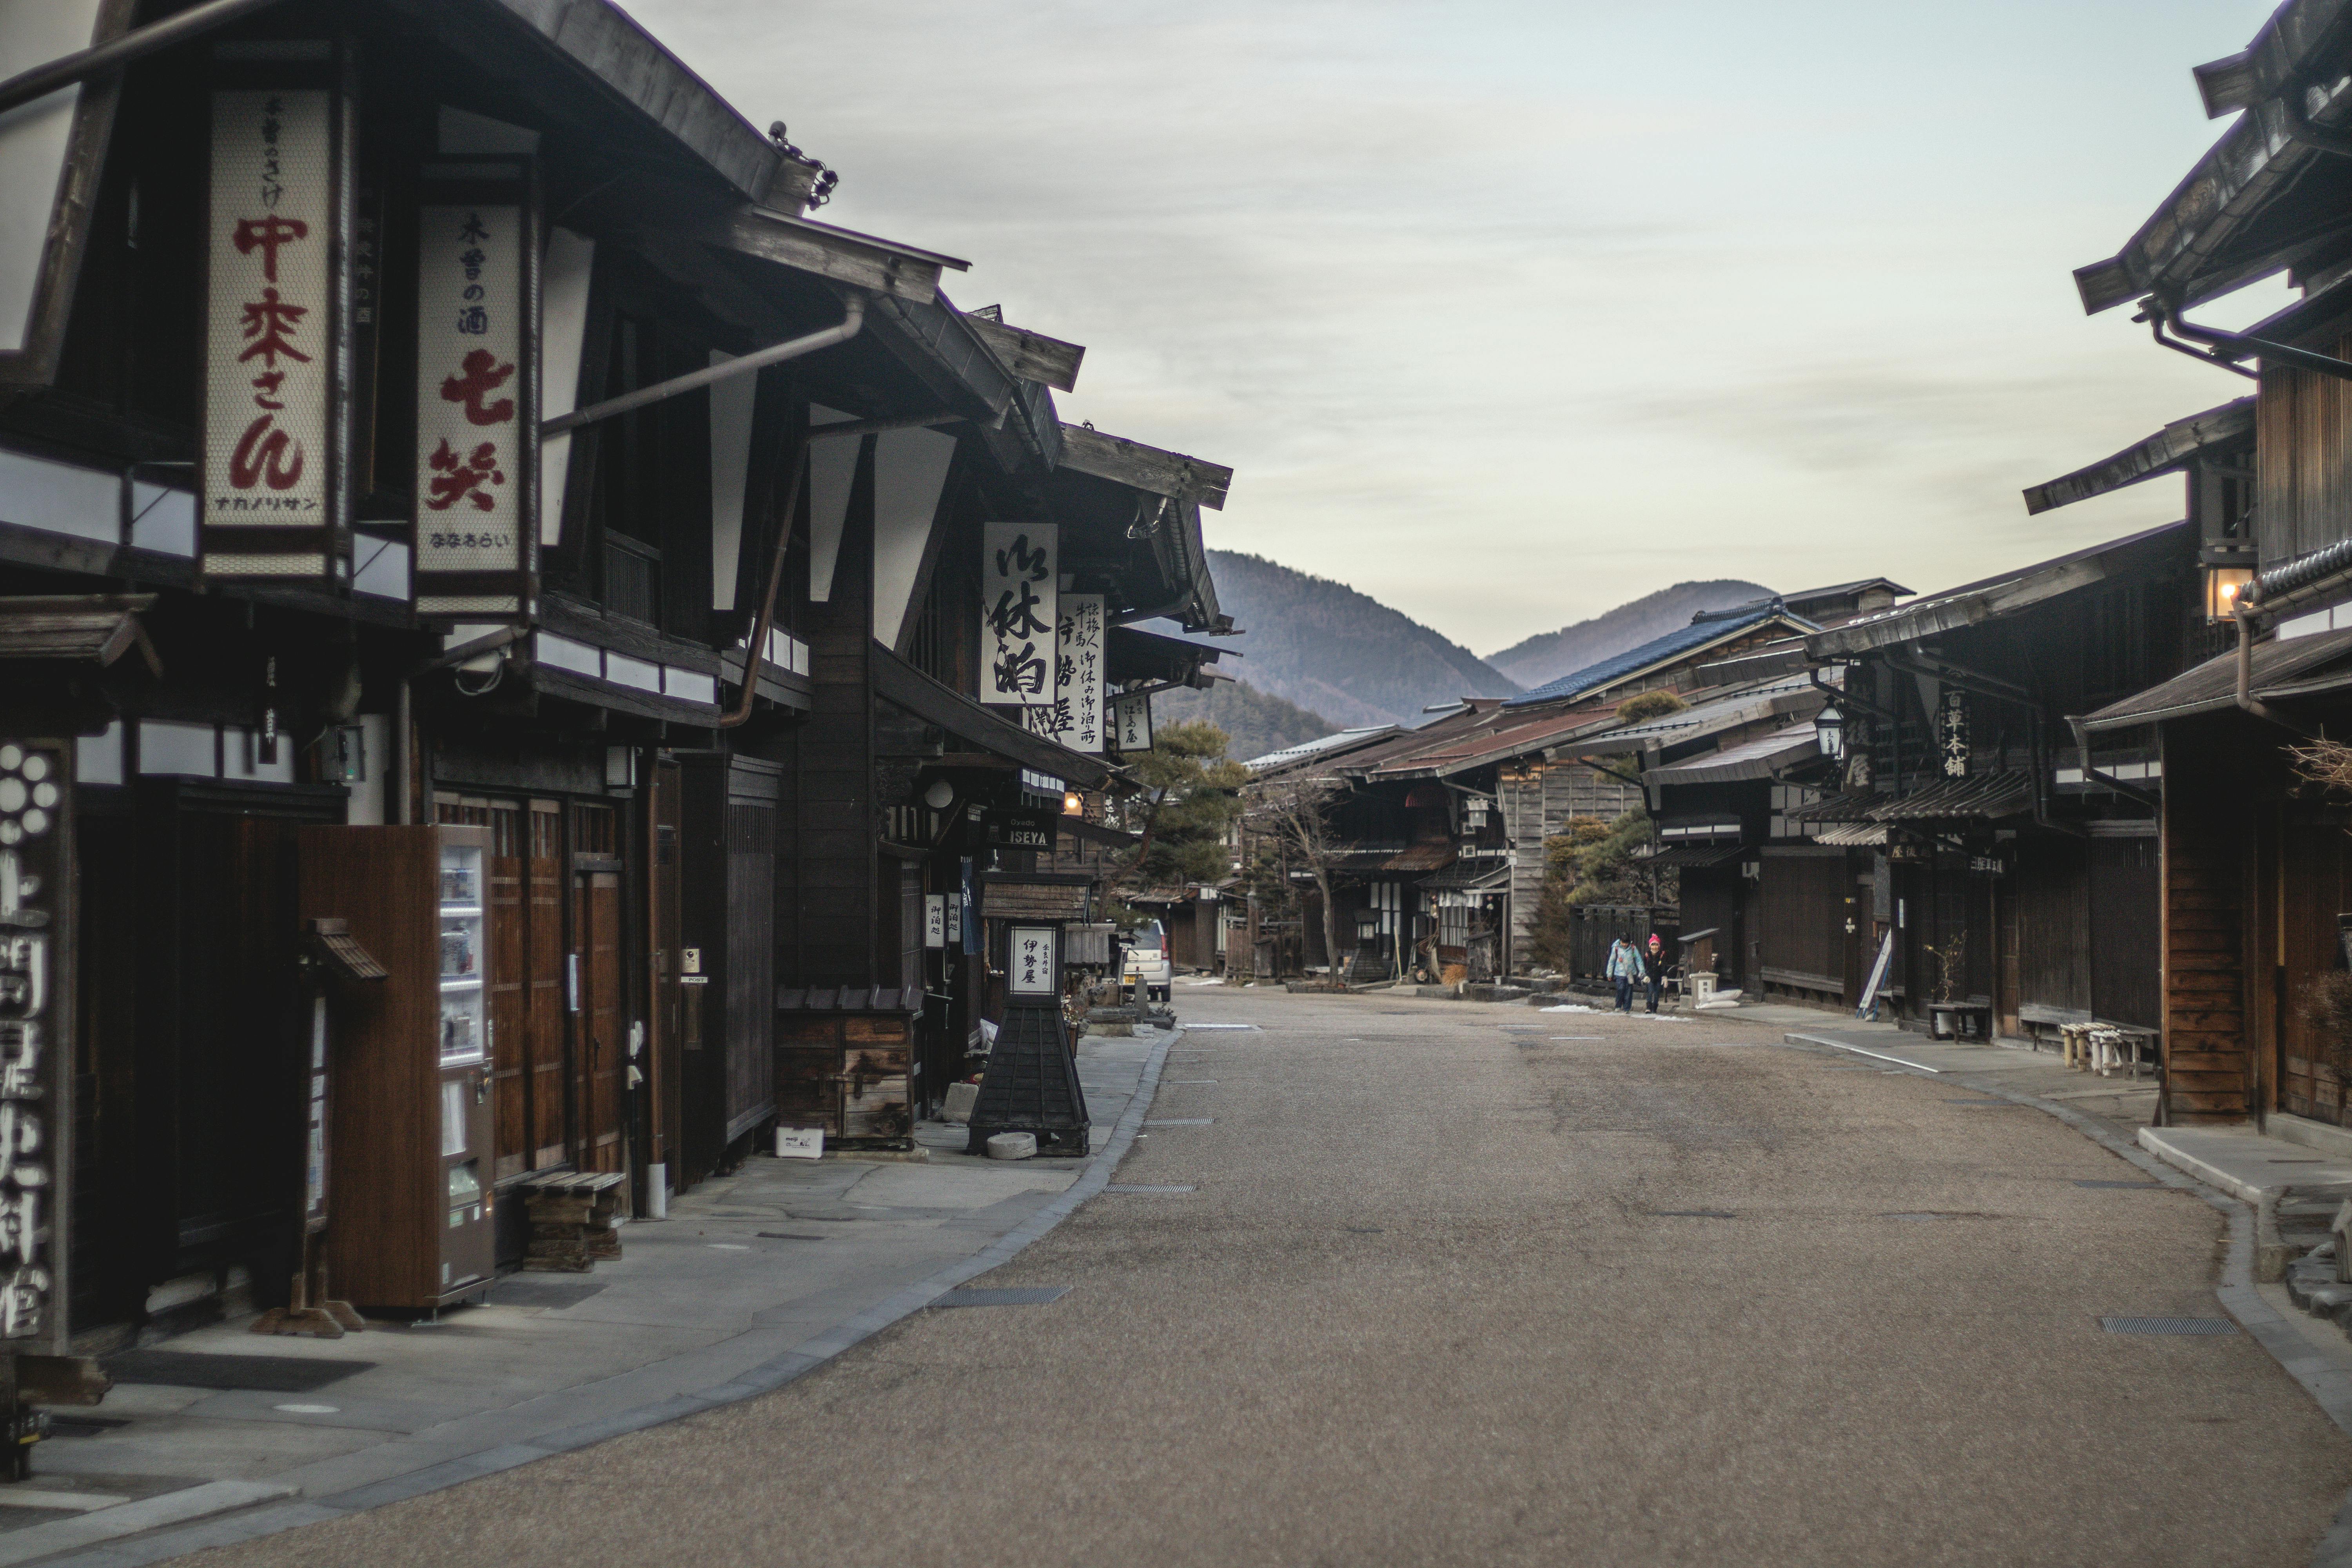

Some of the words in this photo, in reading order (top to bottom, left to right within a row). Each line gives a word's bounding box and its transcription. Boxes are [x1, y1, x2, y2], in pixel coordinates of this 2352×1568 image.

[214, 497, 316, 510] ナカノリサン
[1010, 831, 1046, 844] ISEYA
[1021, 939, 1038, 983] 伊勢屋
